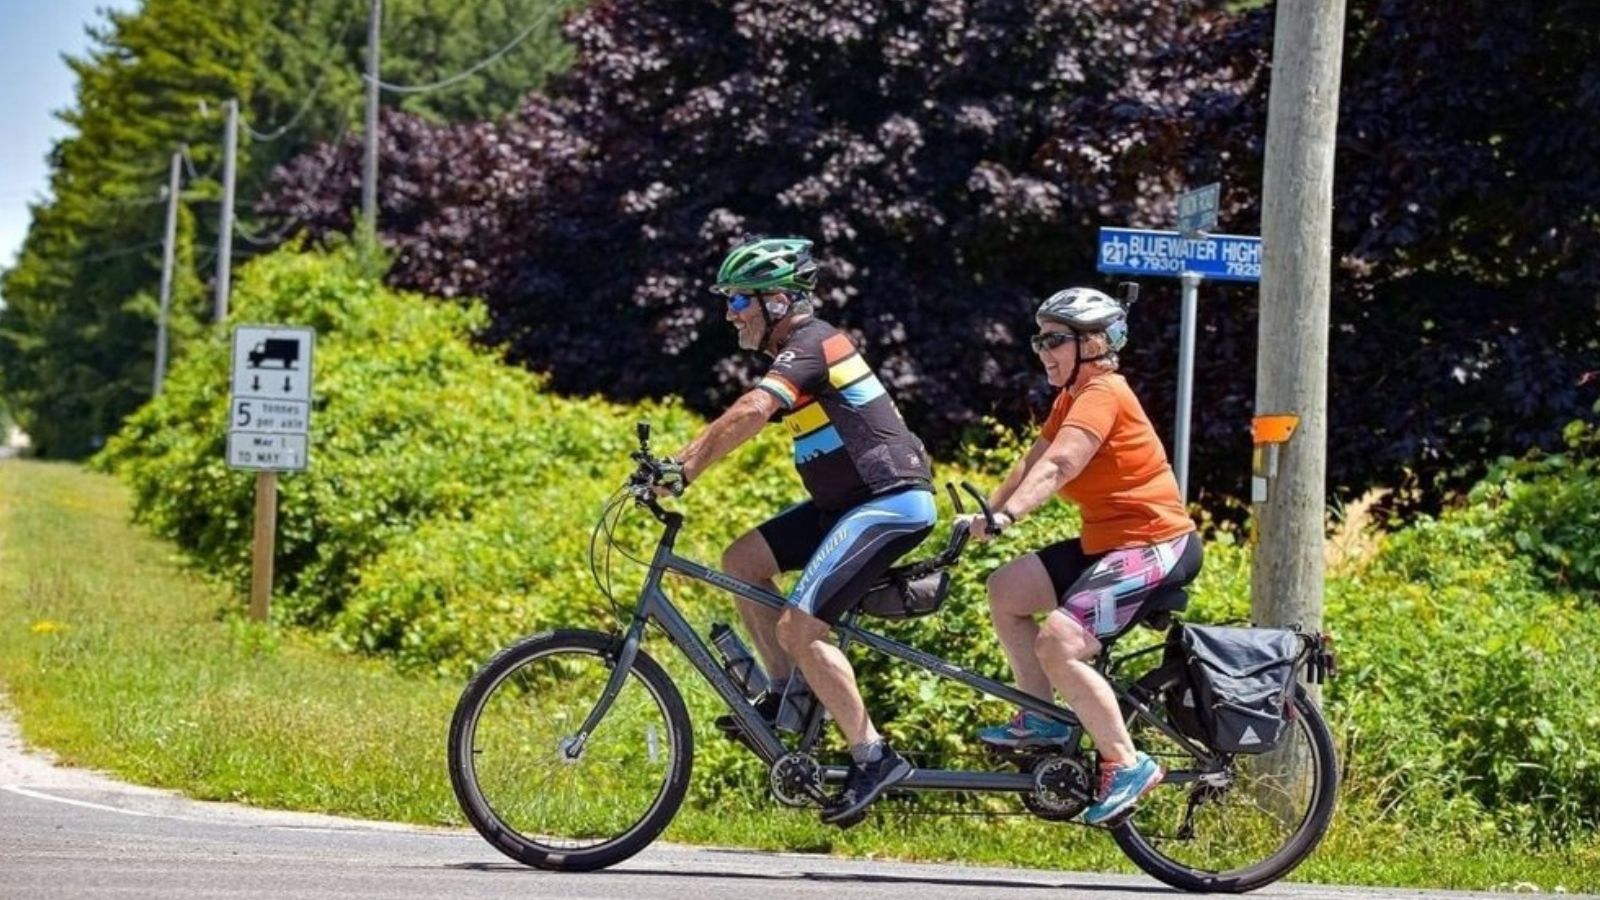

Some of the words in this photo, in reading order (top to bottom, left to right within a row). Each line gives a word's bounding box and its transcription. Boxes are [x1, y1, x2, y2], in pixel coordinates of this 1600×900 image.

[1105, 244, 1125, 263] 21
[1130, 236, 1217, 260] BLUEWATER
[1143, 257, 1186, 272] 79301
[238, 403, 252, 426] 5
